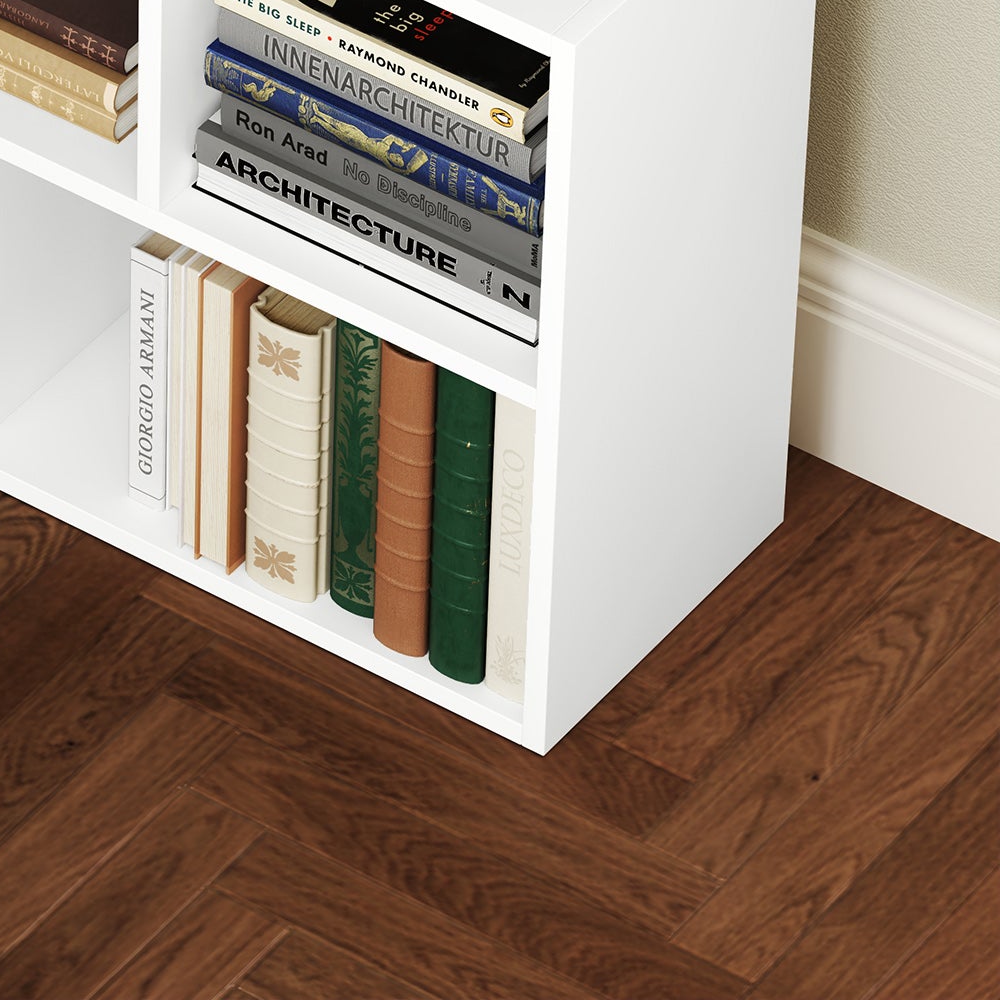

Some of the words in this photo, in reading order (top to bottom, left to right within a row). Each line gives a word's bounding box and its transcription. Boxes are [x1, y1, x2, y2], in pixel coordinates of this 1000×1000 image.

[258, 2, 281, 20] BIG
[286, 15, 321, 37] SLEEP
[338, 39, 406, 77] RAYMOND
[411, 72, 480, 111] CHANDLER
[373, 4, 401, 24] the
[389, 12, 425, 33] big
[414, 9, 454, 41] sleep
[18, 56, 100, 103] LATERCULI
[263, 34, 510, 168] INNENARCHITEKTUR
[215, 150, 458, 278] ARCHITECTURE
[235, 108, 276, 142] Ron
[281, 132, 329, 168] Arad
[342, 157, 371, 186] No
[376, 173, 473, 234] Discipline
[530, 243, 540, 269] MoMA
[139, 287, 156, 381] ARMANI
[138, 383, 154, 477] GIORGIO
[498, 448, 527, 578] LUXDECO
